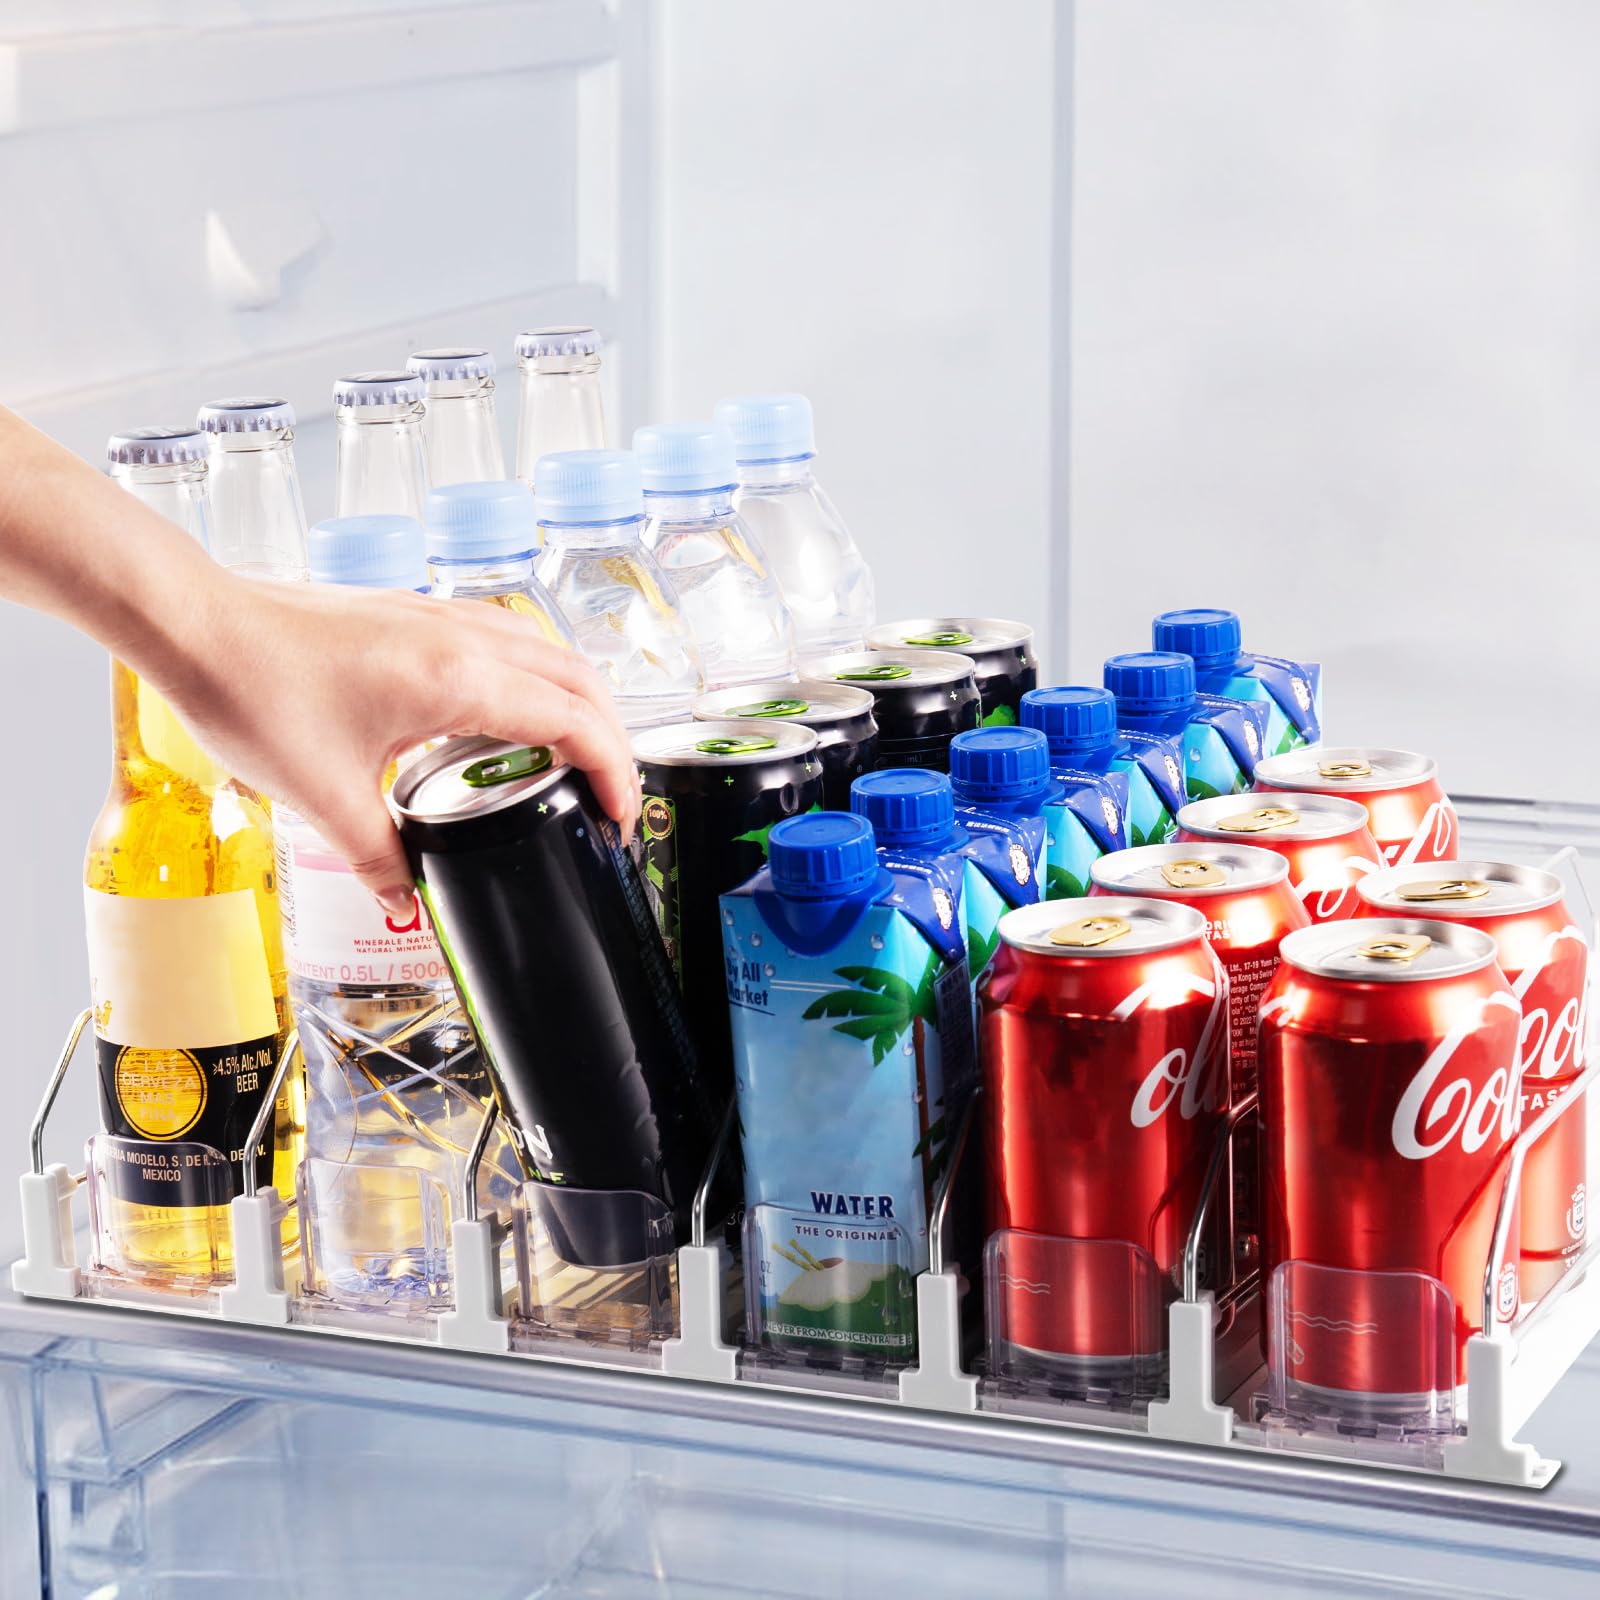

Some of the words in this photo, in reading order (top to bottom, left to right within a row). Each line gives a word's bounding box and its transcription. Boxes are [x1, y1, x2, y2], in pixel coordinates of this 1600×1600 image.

[354, 938, 402, 947] MINERALE
[1205, 930, 1231, 940] TAS
[356, 947, 393, 955] NATURAL
[396, 944, 432, 952] MINERAL
[340, 964, 381, 982] 0.5L
[401, 960, 449, 981] 500m
[742, 961, 761, 983] All
[1231, 985, 1248, 994] verage
[144, 1060, 168, 1073] LA
[241, 1048, 273, 1073] Alc./Vol.
[122, 1072, 197, 1090] CERVEZA
[236, 1073, 259, 1094] BEER
[140, 1091, 175, 1105] MAS
[141, 1107, 176, 1121] FINA
[127, 1151, 170, 1168] MODELO,
[171, 1155, 183, 1168] S.
[186, 1155, 202, 1167] DE
[230, 1150, 244, 1163] DE
[142, 1167, 182, 1182] MEXICO
[810, 1191, 895, 1219] WATER
[795, 1225, 820, 1238] THE
[824, 1228, 899, 1242] ORIGINAL
[765, 1321, 798, 1336] NEVER
[798, 1326, 828, 1339] FROM
